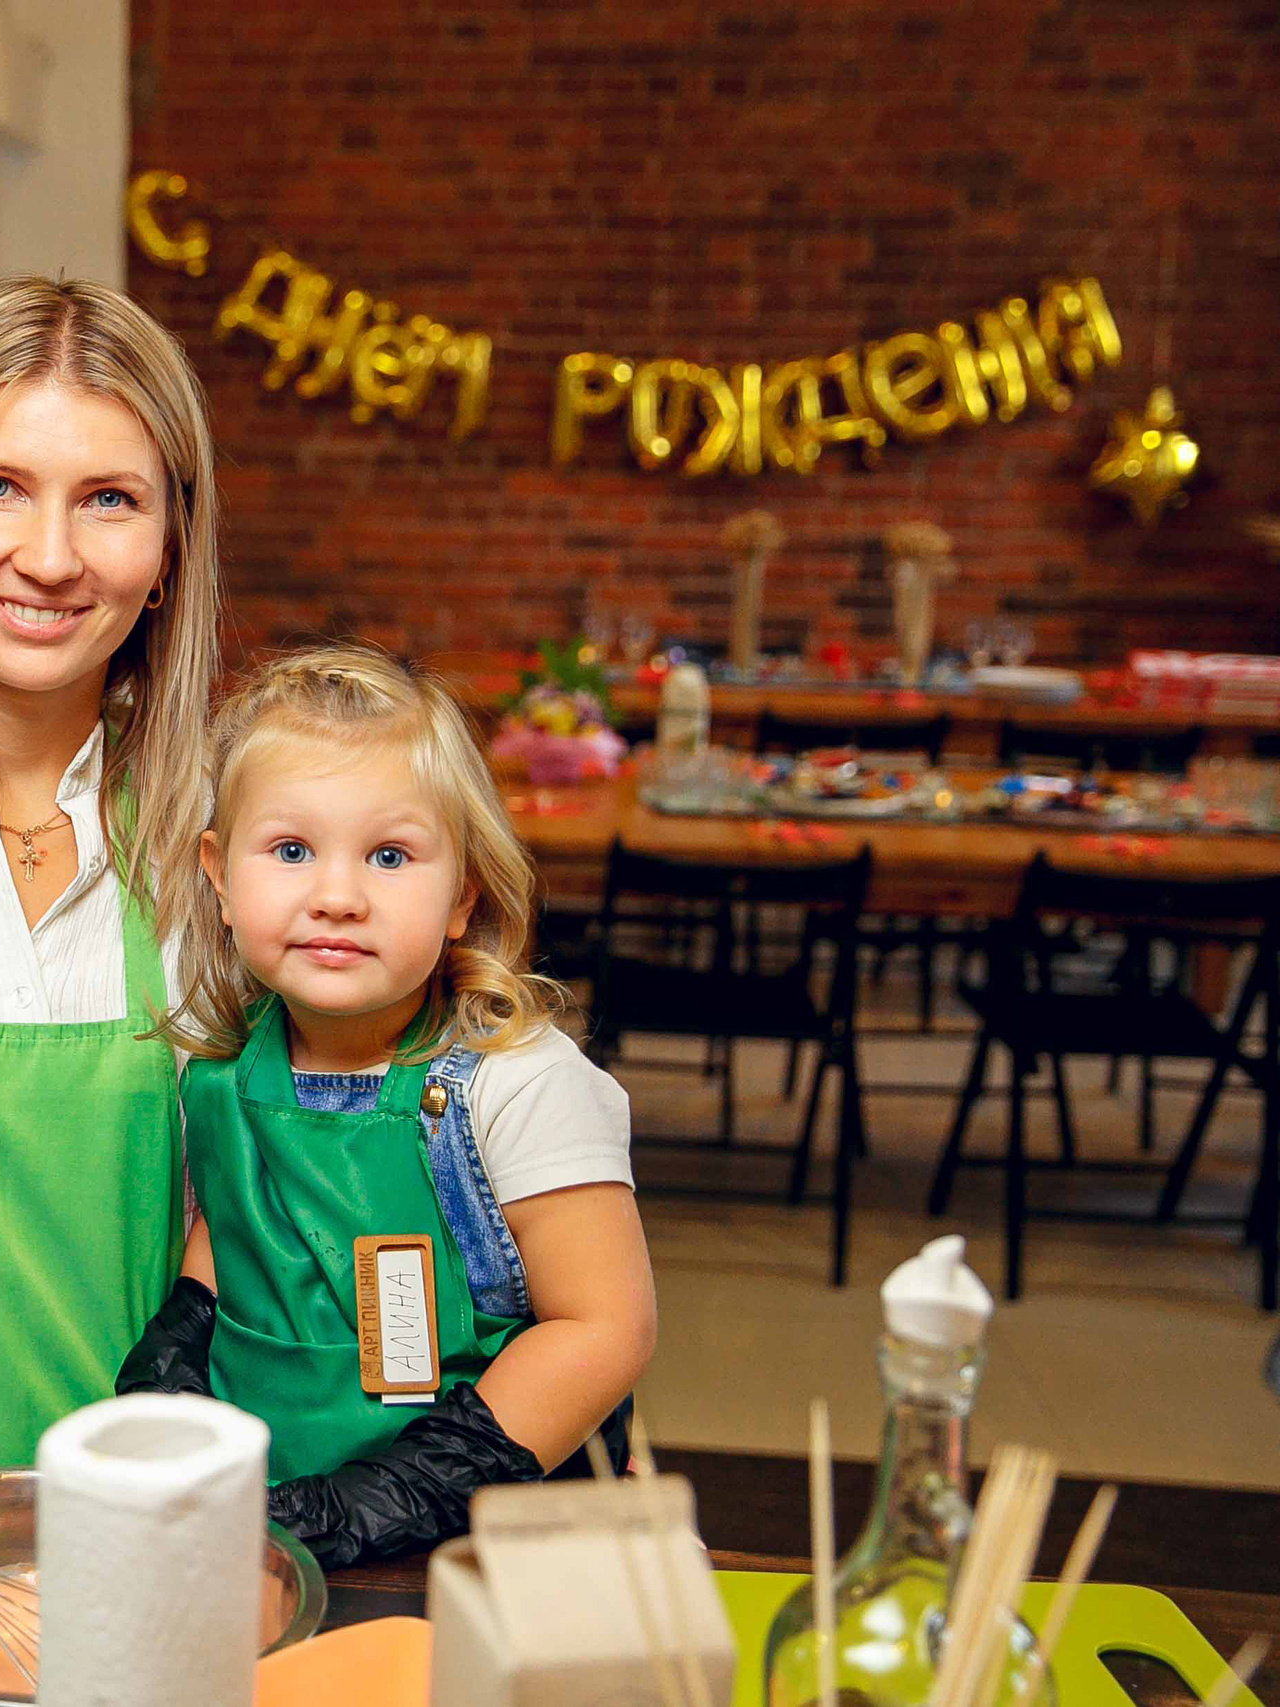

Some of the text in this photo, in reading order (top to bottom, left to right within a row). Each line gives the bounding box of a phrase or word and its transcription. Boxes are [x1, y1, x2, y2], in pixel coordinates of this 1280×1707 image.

[126, 170, 210, 277] С
[359, 1251, 379, 1357] АРТ ПИКНИК
[384, 1270, 425, 1372] АЛИНА
